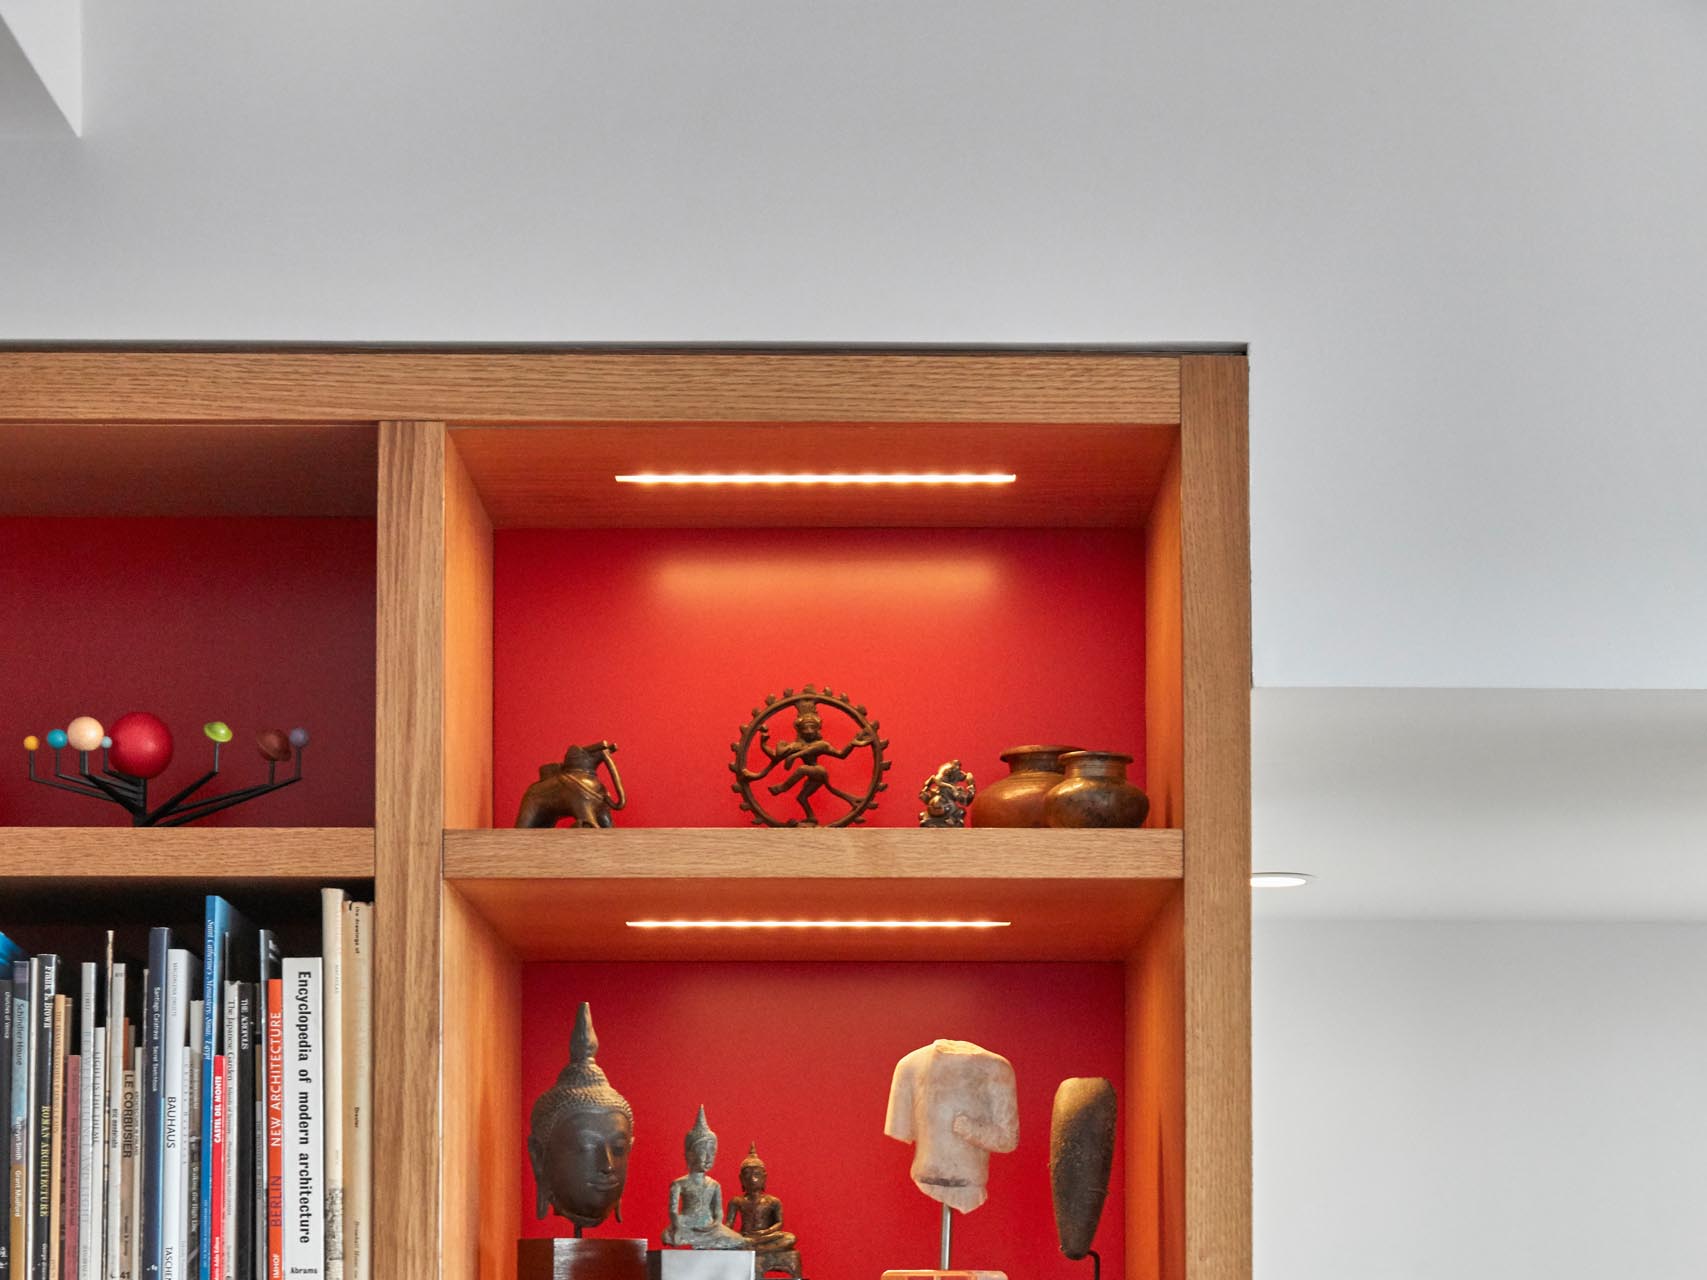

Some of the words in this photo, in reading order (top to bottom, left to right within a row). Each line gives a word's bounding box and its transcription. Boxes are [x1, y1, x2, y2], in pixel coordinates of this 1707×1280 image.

[45, 965, 54, 990] Frank
[43, 1002, 53, 1029] Brown
[227, 999, 235, 1015] The
[296, 971, 311, 1061] Encyclopedia
[16, 1003, 25, 1040] Schindler
[227, 1016, 235, 1050] Japanese
[16, 1041, 24, 1066] House
[227, 1052, 235, 1081] Garden
[270, 1012, 281, 1110] ARCHITECTURE
[124, 1074, 134, 1088] LE
[214, 1075, 222, 1103] MONTE
[298, 1069, 311, 1083] of
[40, 1105, 50, 1138] ROMAN
[166, 1096, 176, 1149] BAUHAUS
[214, 1104, 222, 1117] DEL
[298, 1091, 312, 1145] modern
[123, 1092, 134, 1158] CORBUSIER
[214, 1117, 222, 1143] CASTEL
[271, 1117, 281, 1147] NEW
[15, 1142, 23, 1160] Smith
[14, 1170, 22, 1188] Grant
[39, 1142, 49, 1217] ARCHITECTURE
[271, 1175, 282, 1227] BERLIN
[299, 1152, 312, 1244] architecture
[272, 1253, 280, 1279] IMHOF
[290, 1266, 318, 1275] Abrams
